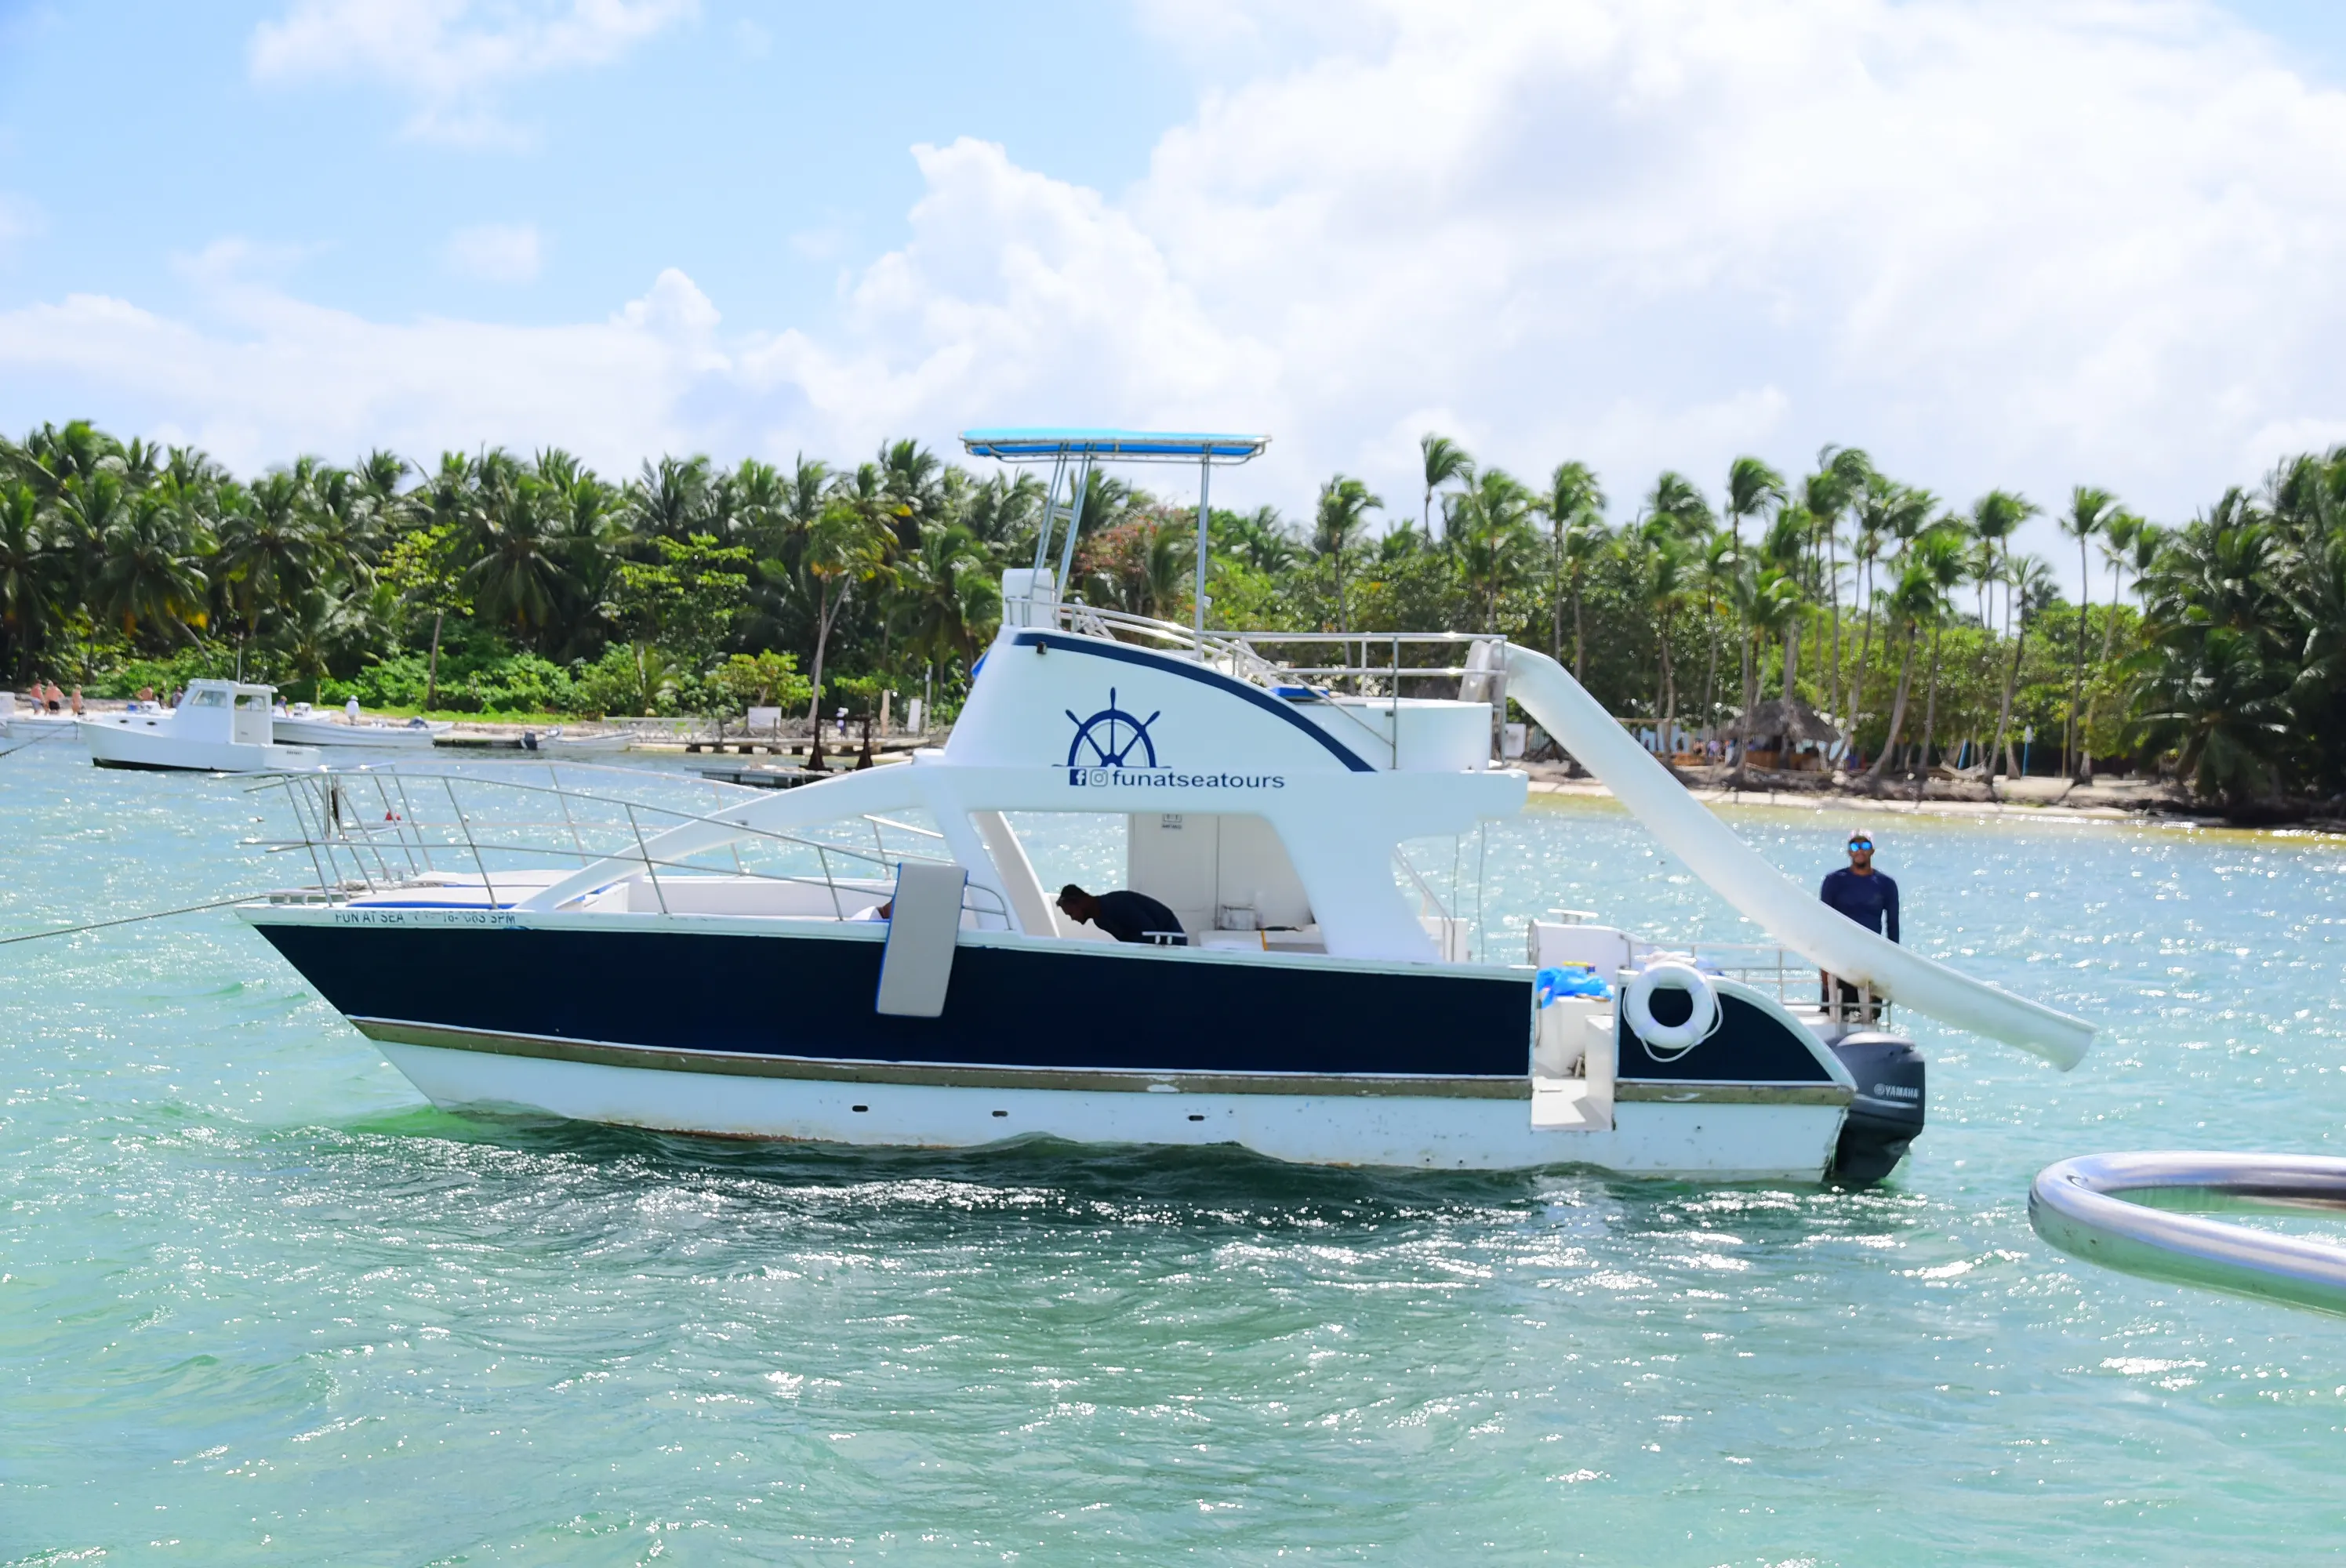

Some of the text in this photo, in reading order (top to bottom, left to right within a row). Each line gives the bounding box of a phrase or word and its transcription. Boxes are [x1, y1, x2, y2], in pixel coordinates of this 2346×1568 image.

[1112, 769, 1285, 789] funatseatours
[335, 910, 359, 923] FUN
[362, 910, 376, 924] AT
[380, 910, 405, 924] SEA
[1885, 1085, 1919, 1099] YAMAHA
